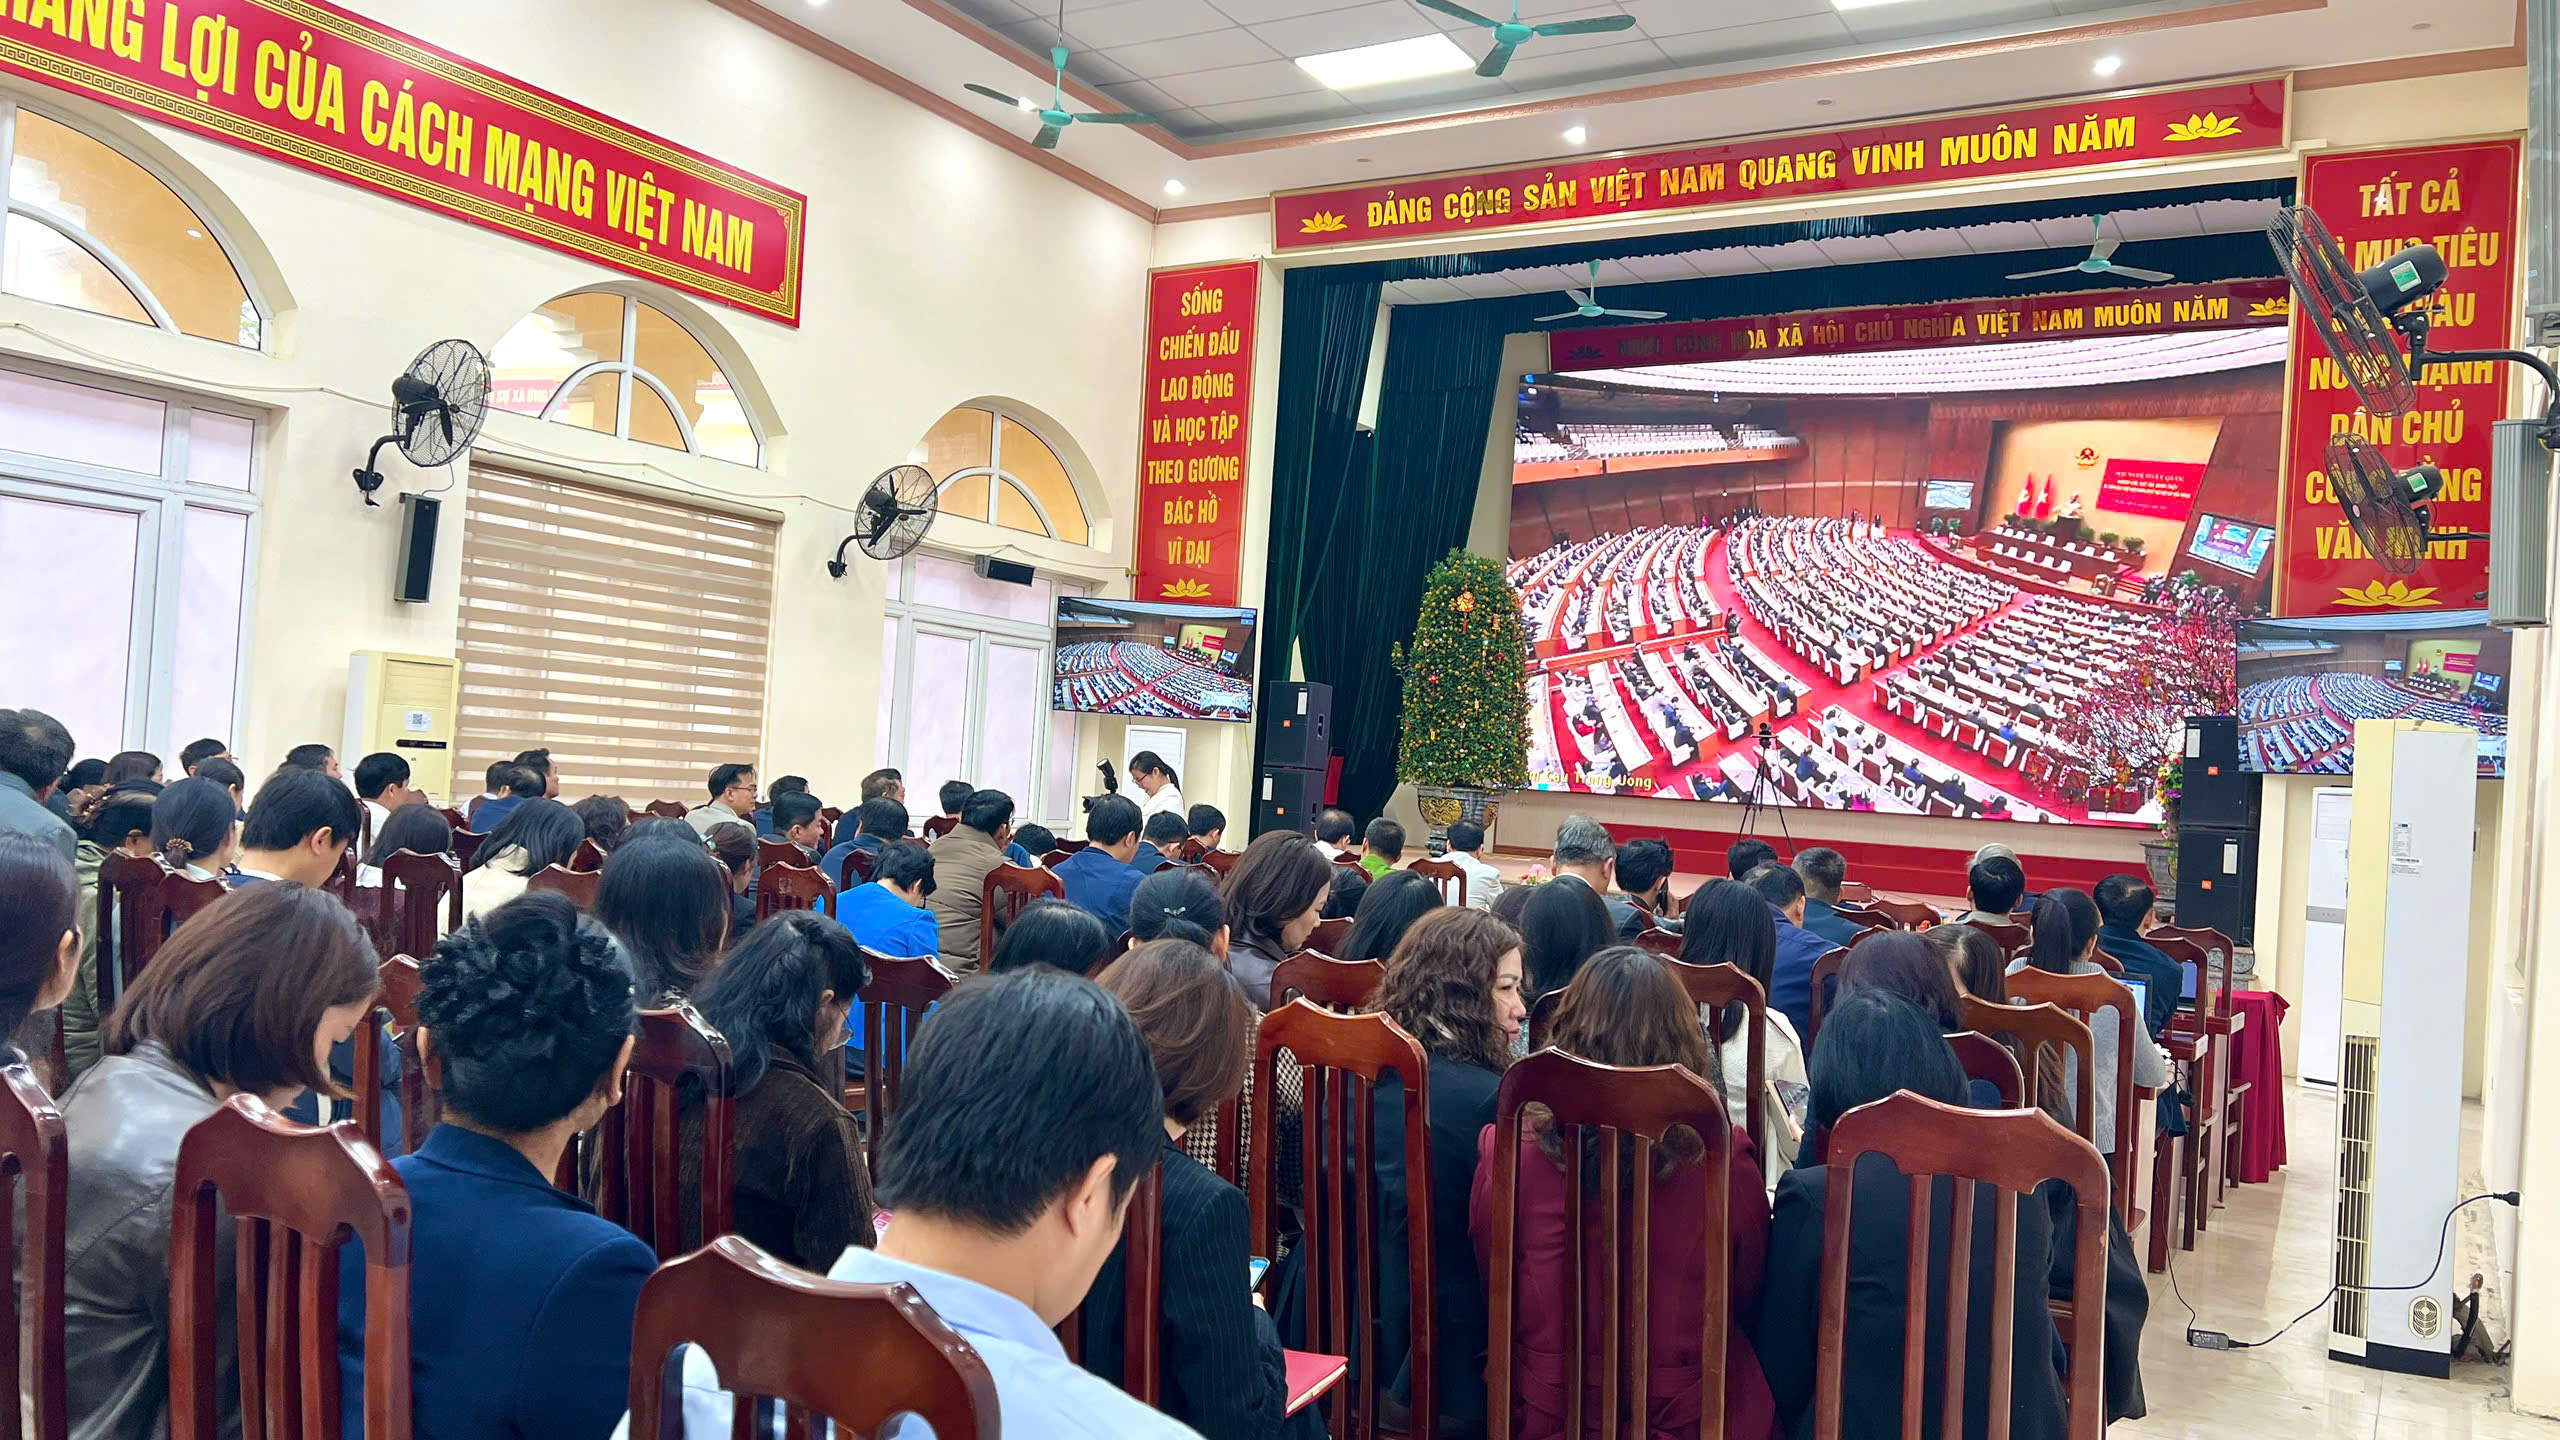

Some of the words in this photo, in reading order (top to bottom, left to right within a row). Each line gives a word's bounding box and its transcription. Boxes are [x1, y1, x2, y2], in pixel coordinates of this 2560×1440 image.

[160, 2, 239, 103] LỢI
[254, 30, 346, 135] CỦA
[360, 78, 473, 178] CÁCH
[483, 124, 595, 219] MẠNG
[606, 170, 675, 252] VIỆT
[681, 198, 754, 274] NAM
[1367, 190, 1432, 227] ĐẢNG
[1443, 186, 1511, 223] CỘNG
[1524, 170, 1577, 211] SẢN
[1590, 167, 1647, 207] VIỆT
[1660, 163, 1725, 197] NAM
[1739, 150, 1836, 190] QUANG
[1851, 141, 1925, 176] VINH
[1940, 124, 2037, 167] MUÔN
[2053, 113, 2136, 155] NĂM
[2359, 170, 2413, 218] TẤT
[2420, 167, 2461, 214] CẢ
[2432, 226, 2499, 268] TIÊU
[1180, 281, 1223, 317] SỐNG
[1159, 325, 1205, 361] CHIẾN
[1208, 322, 1241, 357] ĐẤU
[1777, 322, 1804, 348] XÃ
[1812, 320, 1845, 348] HỘI
[1855, 314, 1894, 342] CHỦ
[1904, 313, 1966, 340] NGHĨA
[1976, 309, 2021, 338] VIỆT
[2033, 306, 2083, 331] NAM
[2094, 299, 2162, 327] MUÔN
[2173, 295, 2229, 323] NĂM
[1160, 376, 1188, 403] LAO
[1191, 369, 1234, 404] ĐỘNG
[1152, 414, 1172, 444] VÀ
[1175, 416, 1206, 447] HỌC
[1209, 410, 1239, 445] TẬP
[2330, 406, 2393, 447] DÂN
[2402, 398, 2465, 445] CHỦ
[1147, 458, 1184, 485] THEO
[1188, 455, 1240, 484] GƯƠNG
[2399, 455, 2482, 503] NG
[1163, 495, 1194, 525] BÁC
[1197, 489, 1220, 524] HỒ
[1167, 536, 1184, 565] VĨ
[1186, 539, 1211, 569] ĐẠI
